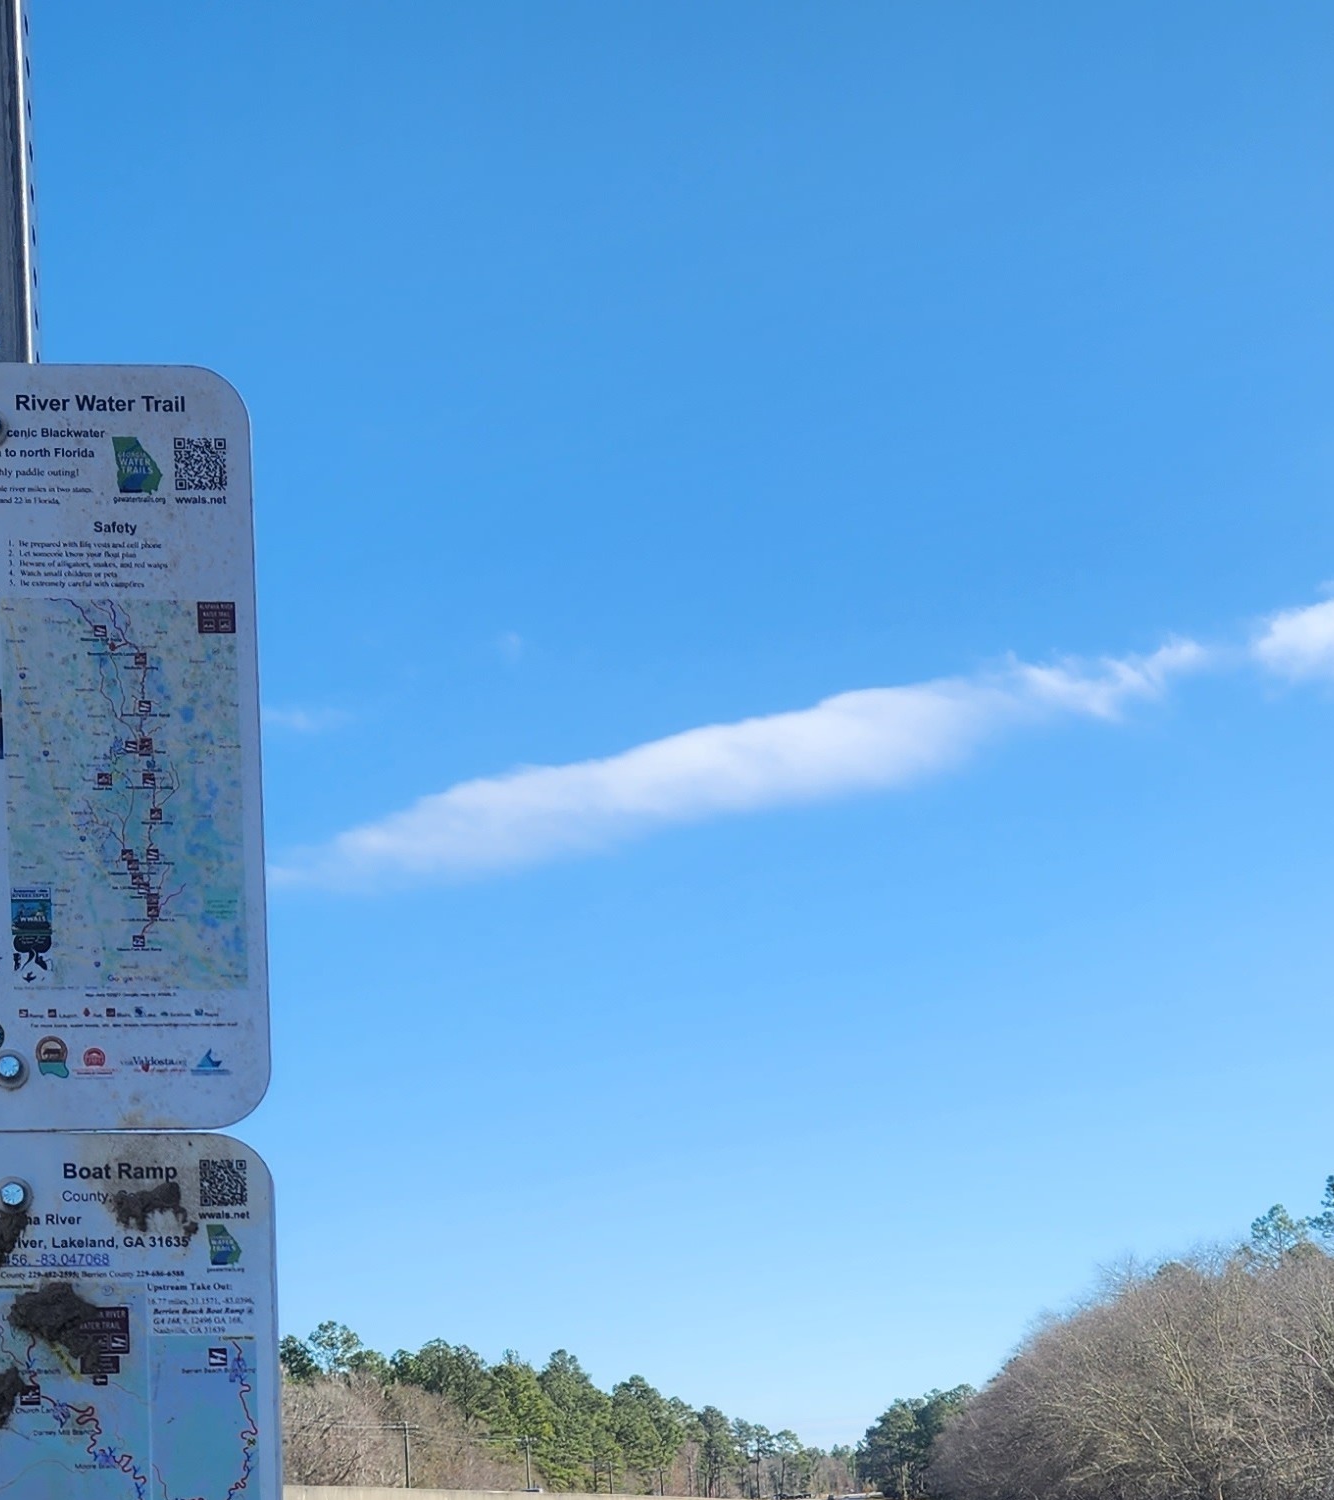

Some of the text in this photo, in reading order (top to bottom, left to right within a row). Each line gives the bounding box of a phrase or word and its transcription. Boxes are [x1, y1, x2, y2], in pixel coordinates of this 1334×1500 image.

[16, 394, 70, 411] River
[75, 396, 135, 412] Water
[140, 395, 185, 412] Trail
[6, 428, 38, 438] cenic
[41, 428, 105, 438] Blackwater
[4, 448, 16, 457] to
[19, 447, 50, 457] north
[53, 448, 94, 458] Florida
[119, 458, 151, 466] WATER
[15, 468, 45, 479] paddle
[47, 468, 79, 479] outing!
[121, 466, 154, 474] TRAILS
[174, 496, 226, 504] wwals.net
[94, 522, 137, 536] Safety
[63, 1163, 112, 1179] Boat
[118, 1163, 178, 1182] Ramp
[45, 1214, 82, 1225] River
[198, 1211, 250, 1220] wwals.net
[52, 1236, 120, 1250] Lakeland,
[123, 1236, 145, 1247] GA
[148, 1235, 189, 1247] 31635
[36, 1253, 110, 1266] -83.047068
[147, 1283, 188, 1292] Upstream
[190, 1282, 211, 1290] Take
